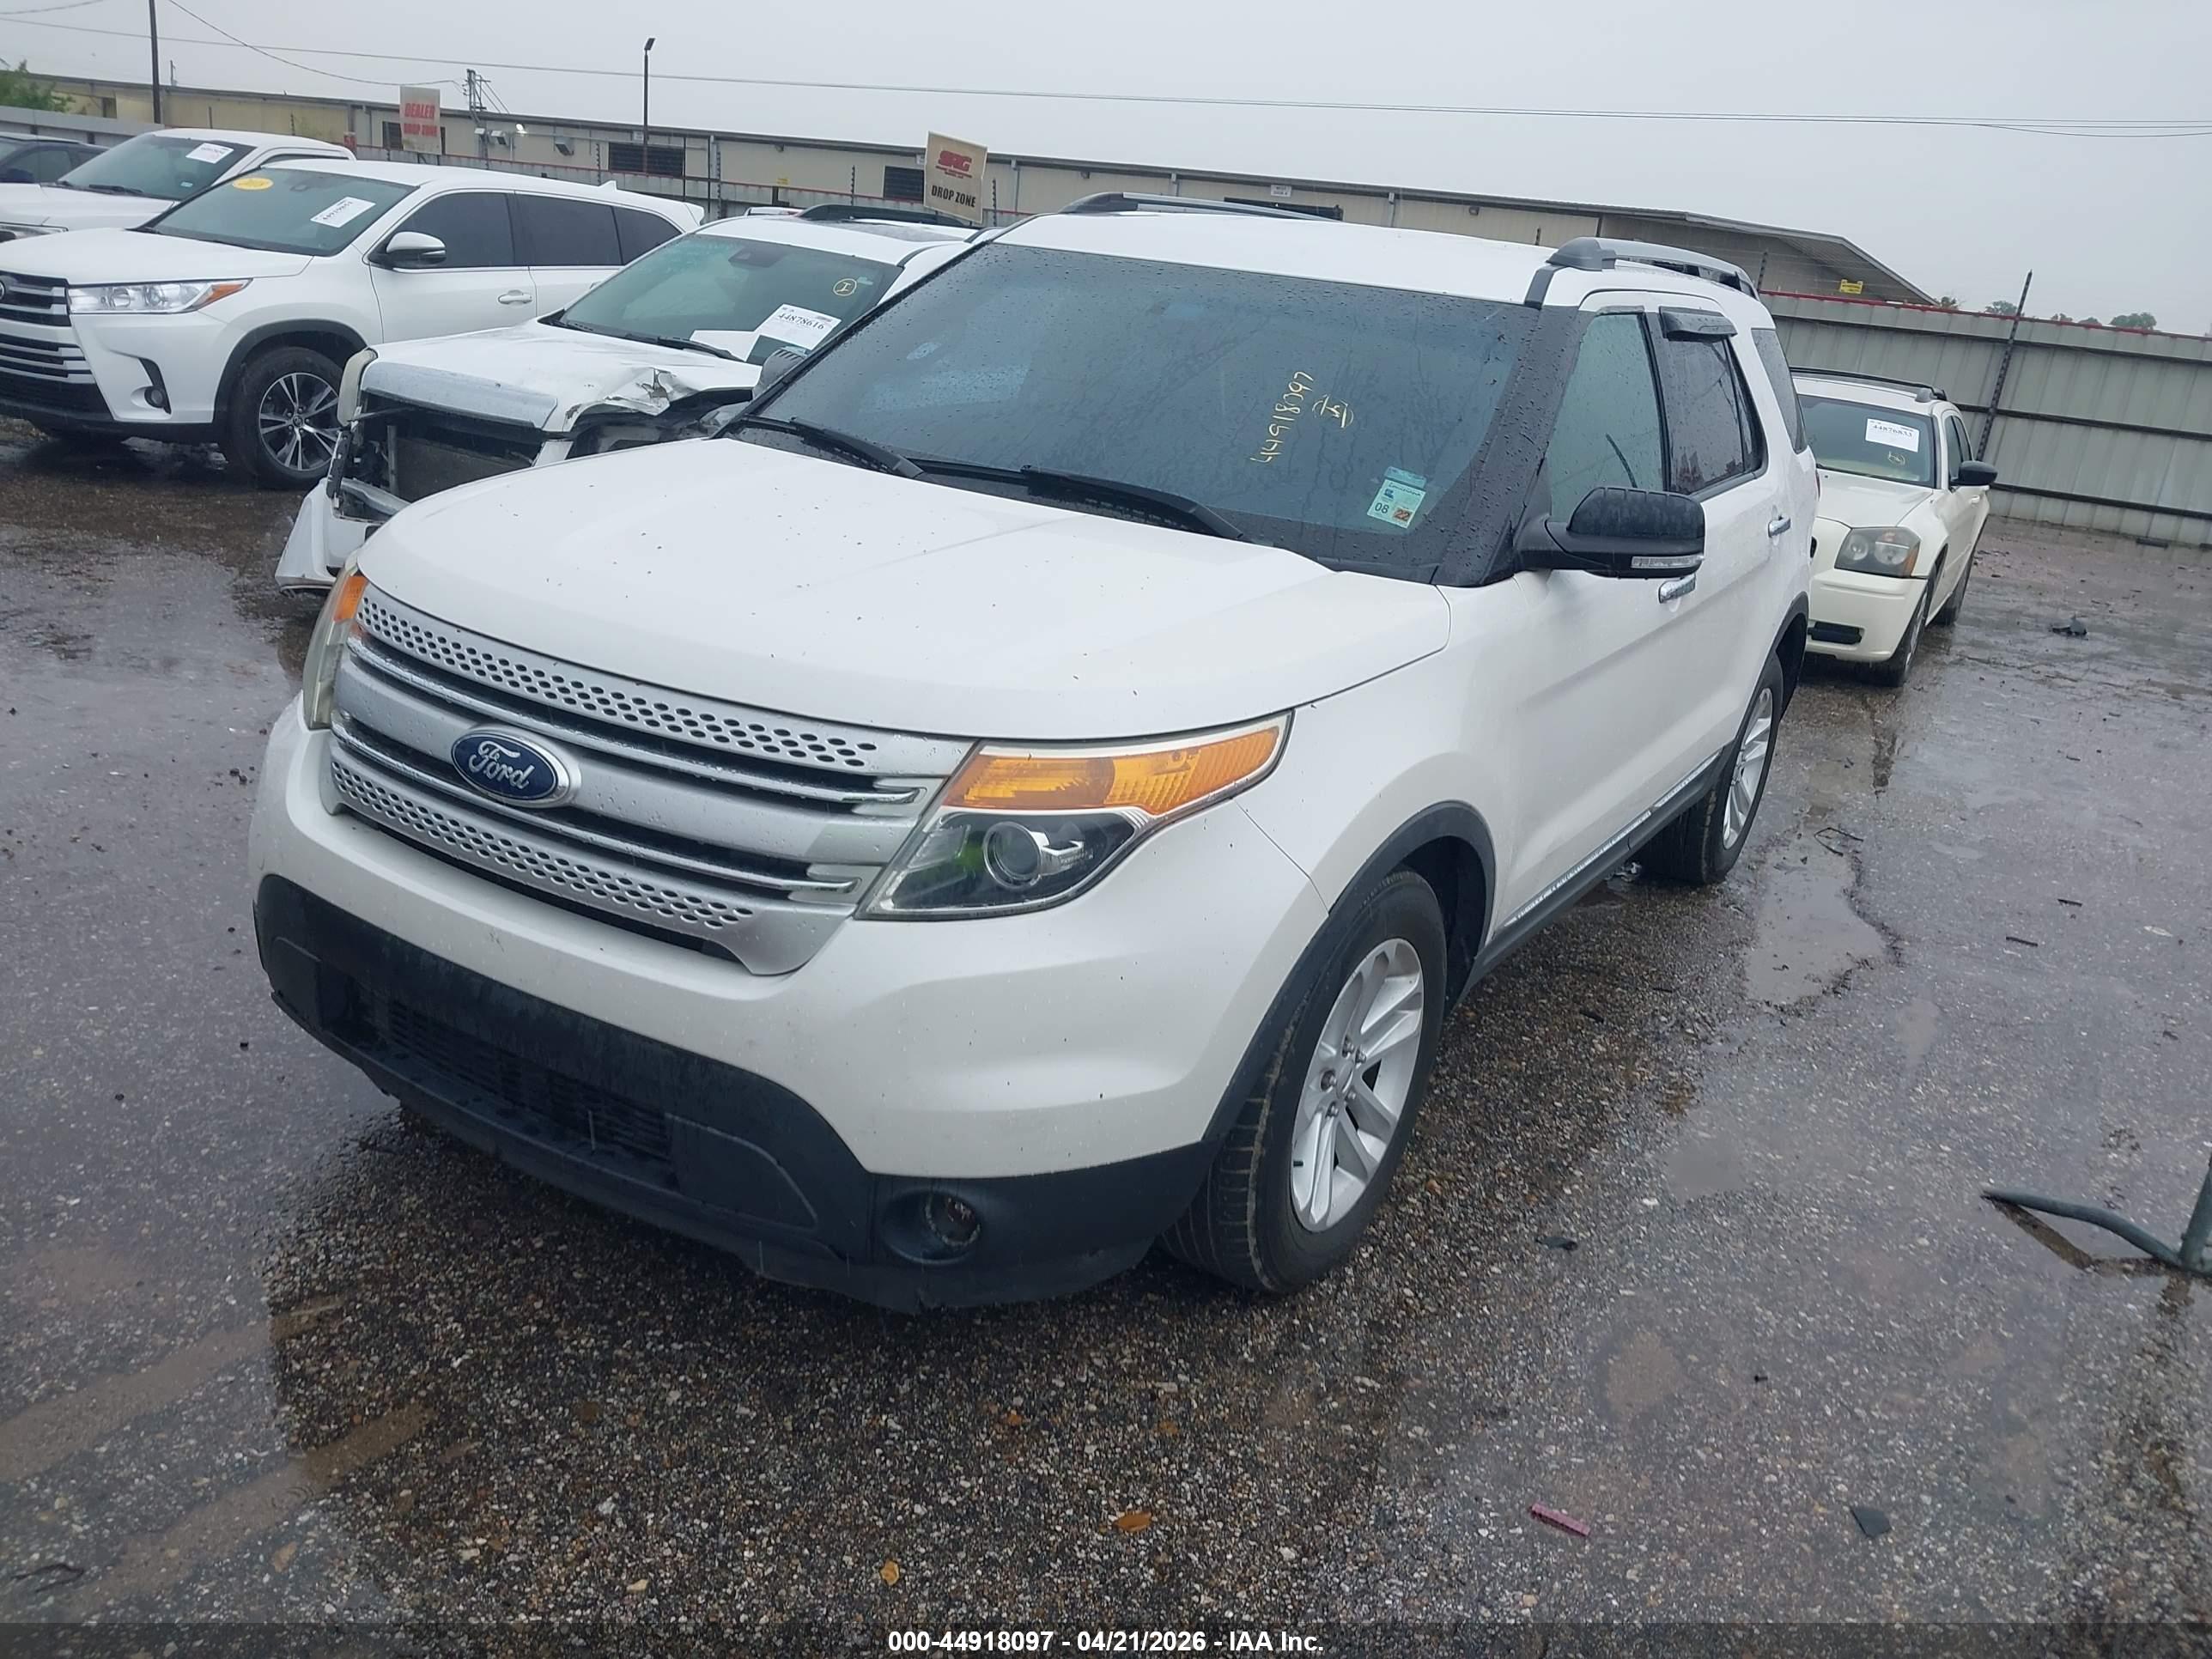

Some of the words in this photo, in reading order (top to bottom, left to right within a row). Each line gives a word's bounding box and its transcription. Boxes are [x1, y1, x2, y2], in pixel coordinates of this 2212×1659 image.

[404, 102, 435, 118] DEALER
[931, 185, 954, 201] DROP
[955, 191, 976, 208] ZONE
[778, 312, 824, 331] 44878616
[1250, 371, 1314, 463] 44918097
[1375, 502, 1389, 514] 08
[1394, 509, 1412, 521] 22
[469, 741, 535, 789] Ford
